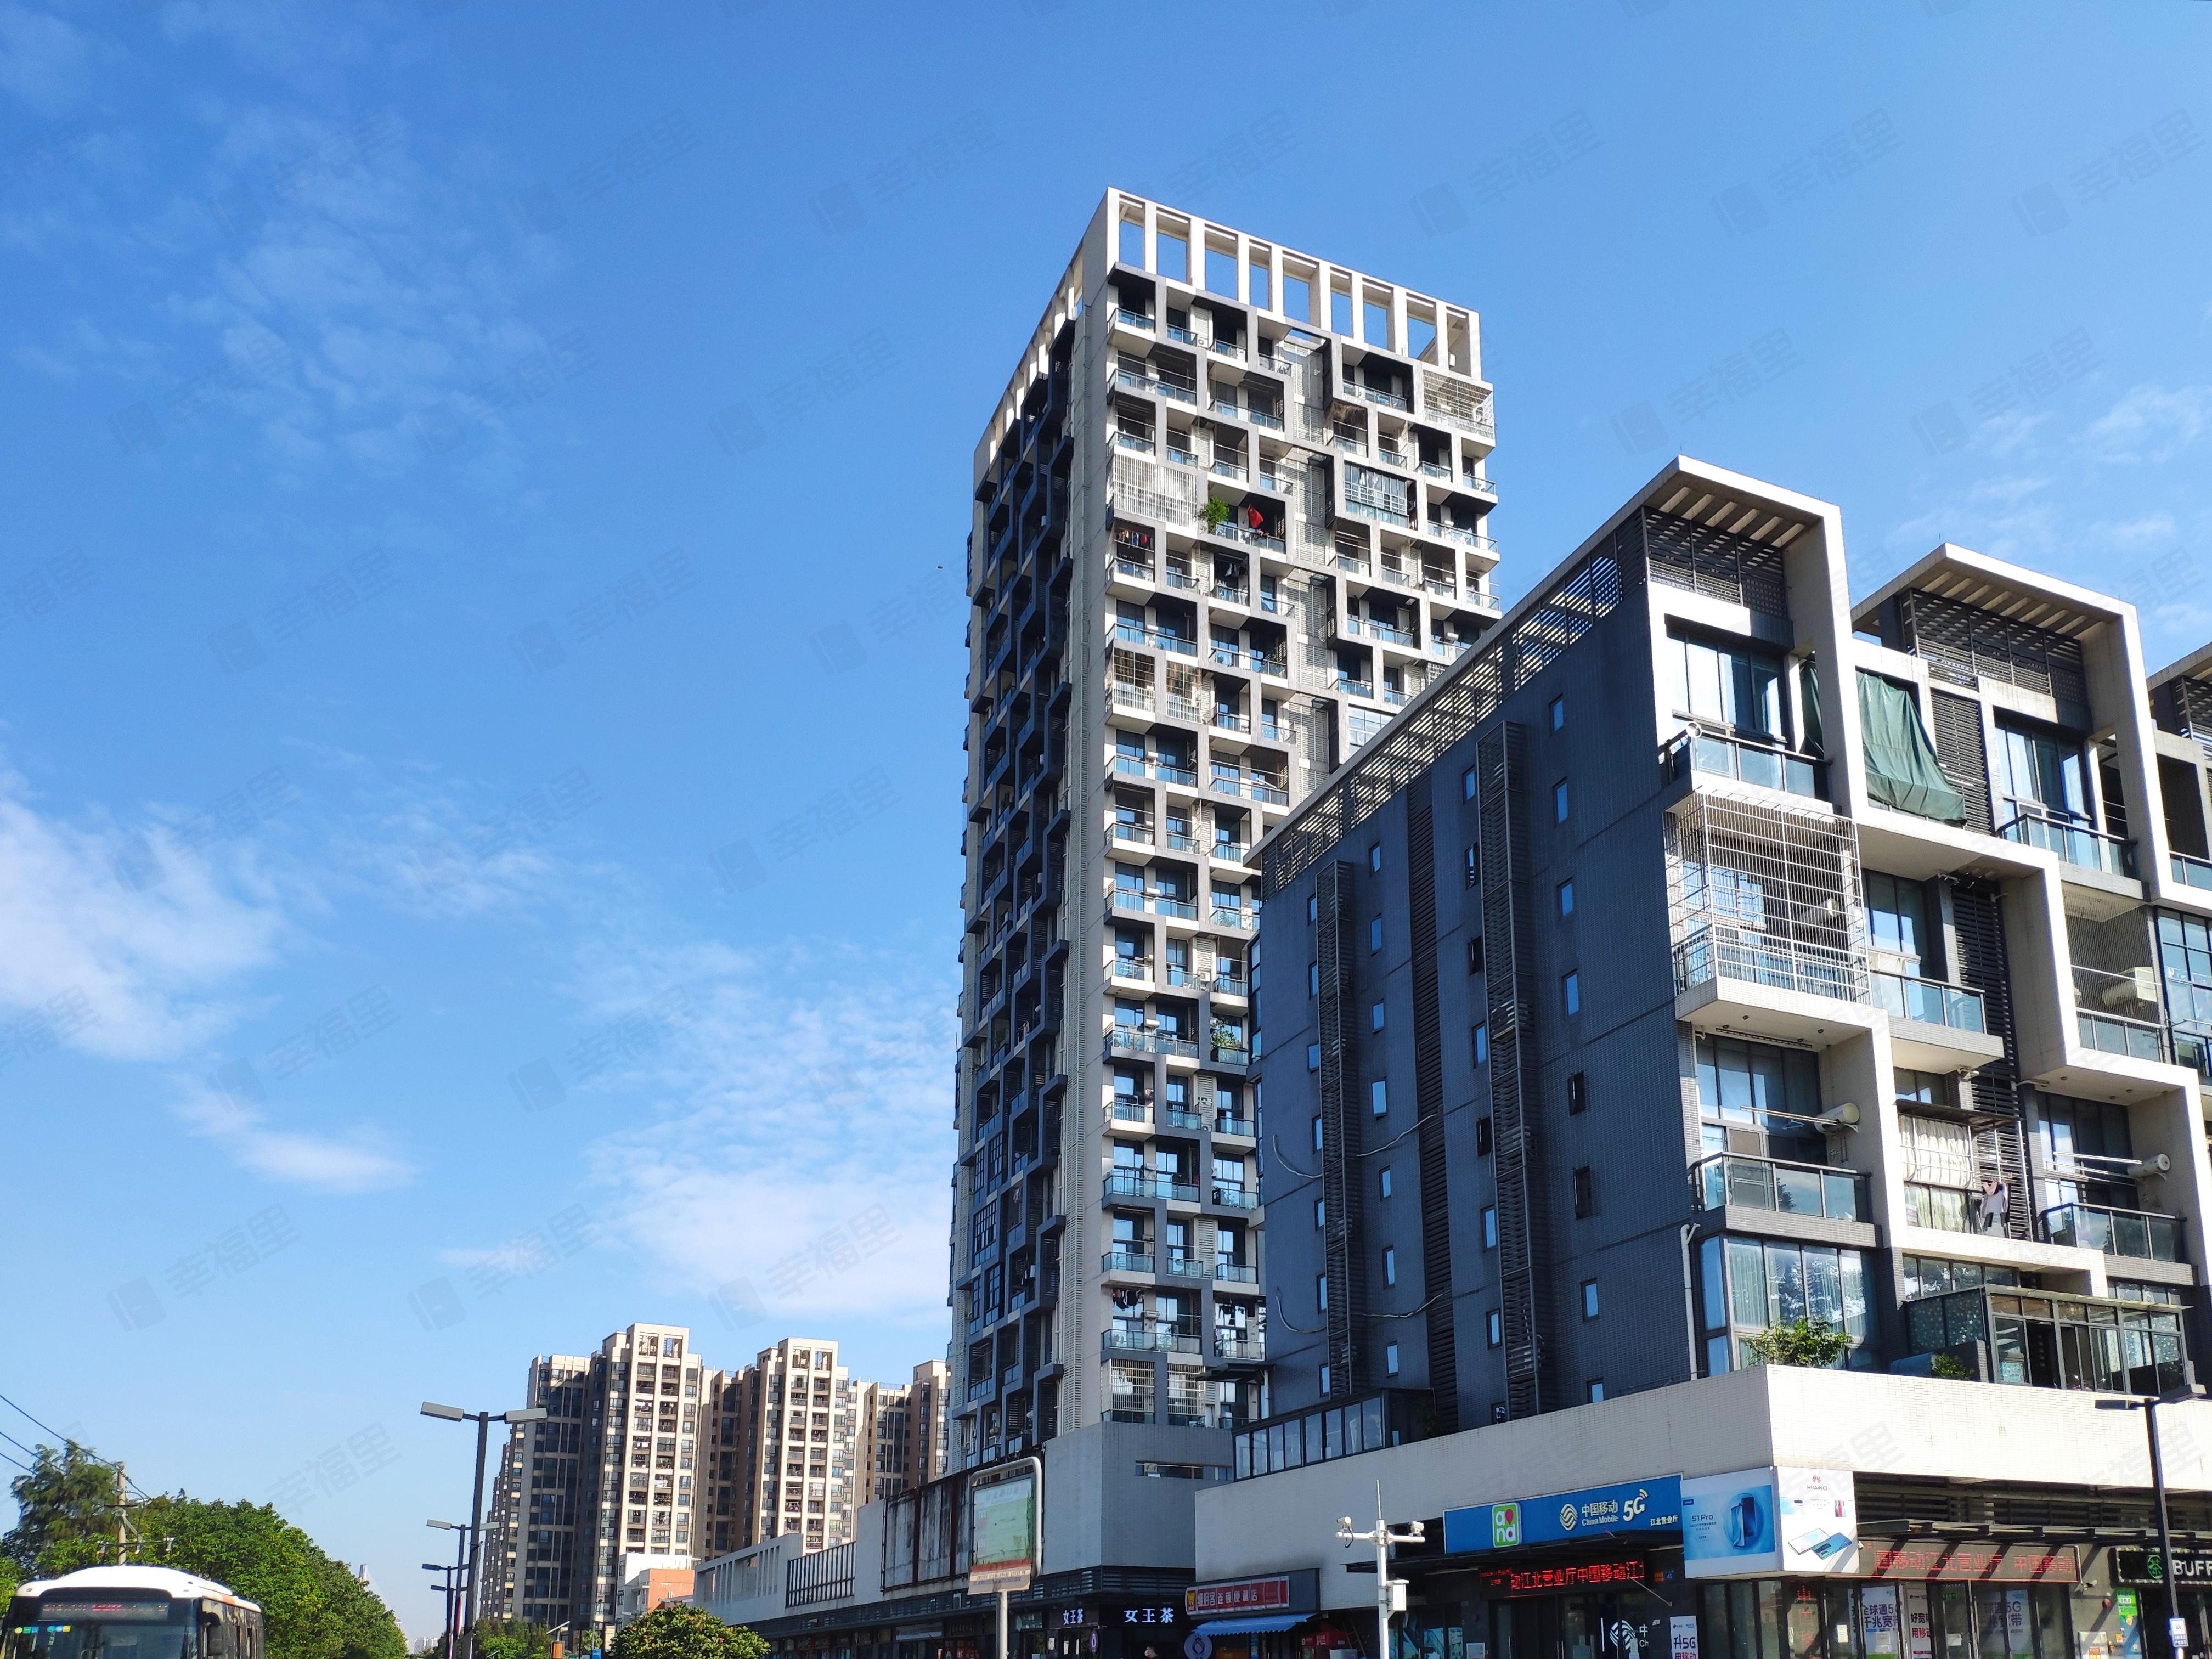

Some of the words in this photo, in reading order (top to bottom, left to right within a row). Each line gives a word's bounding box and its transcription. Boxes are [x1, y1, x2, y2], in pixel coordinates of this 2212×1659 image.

[1582, 1499, 1618, 1518] 中国移动
[1623, 1497, 1645, 1522] 5G
[1582, 1517, 1598, 1526] China
[1599, 1515, 1618, 1524] Mobile
[1650, 1515, 1679, 1526] 江北营业厅
[1063, 1608, 1084, 1626] 女王茶
[1124, 1607, 1174, 1624] 女王茶
[1863, 1604, 1898, 1616] 全球通5
